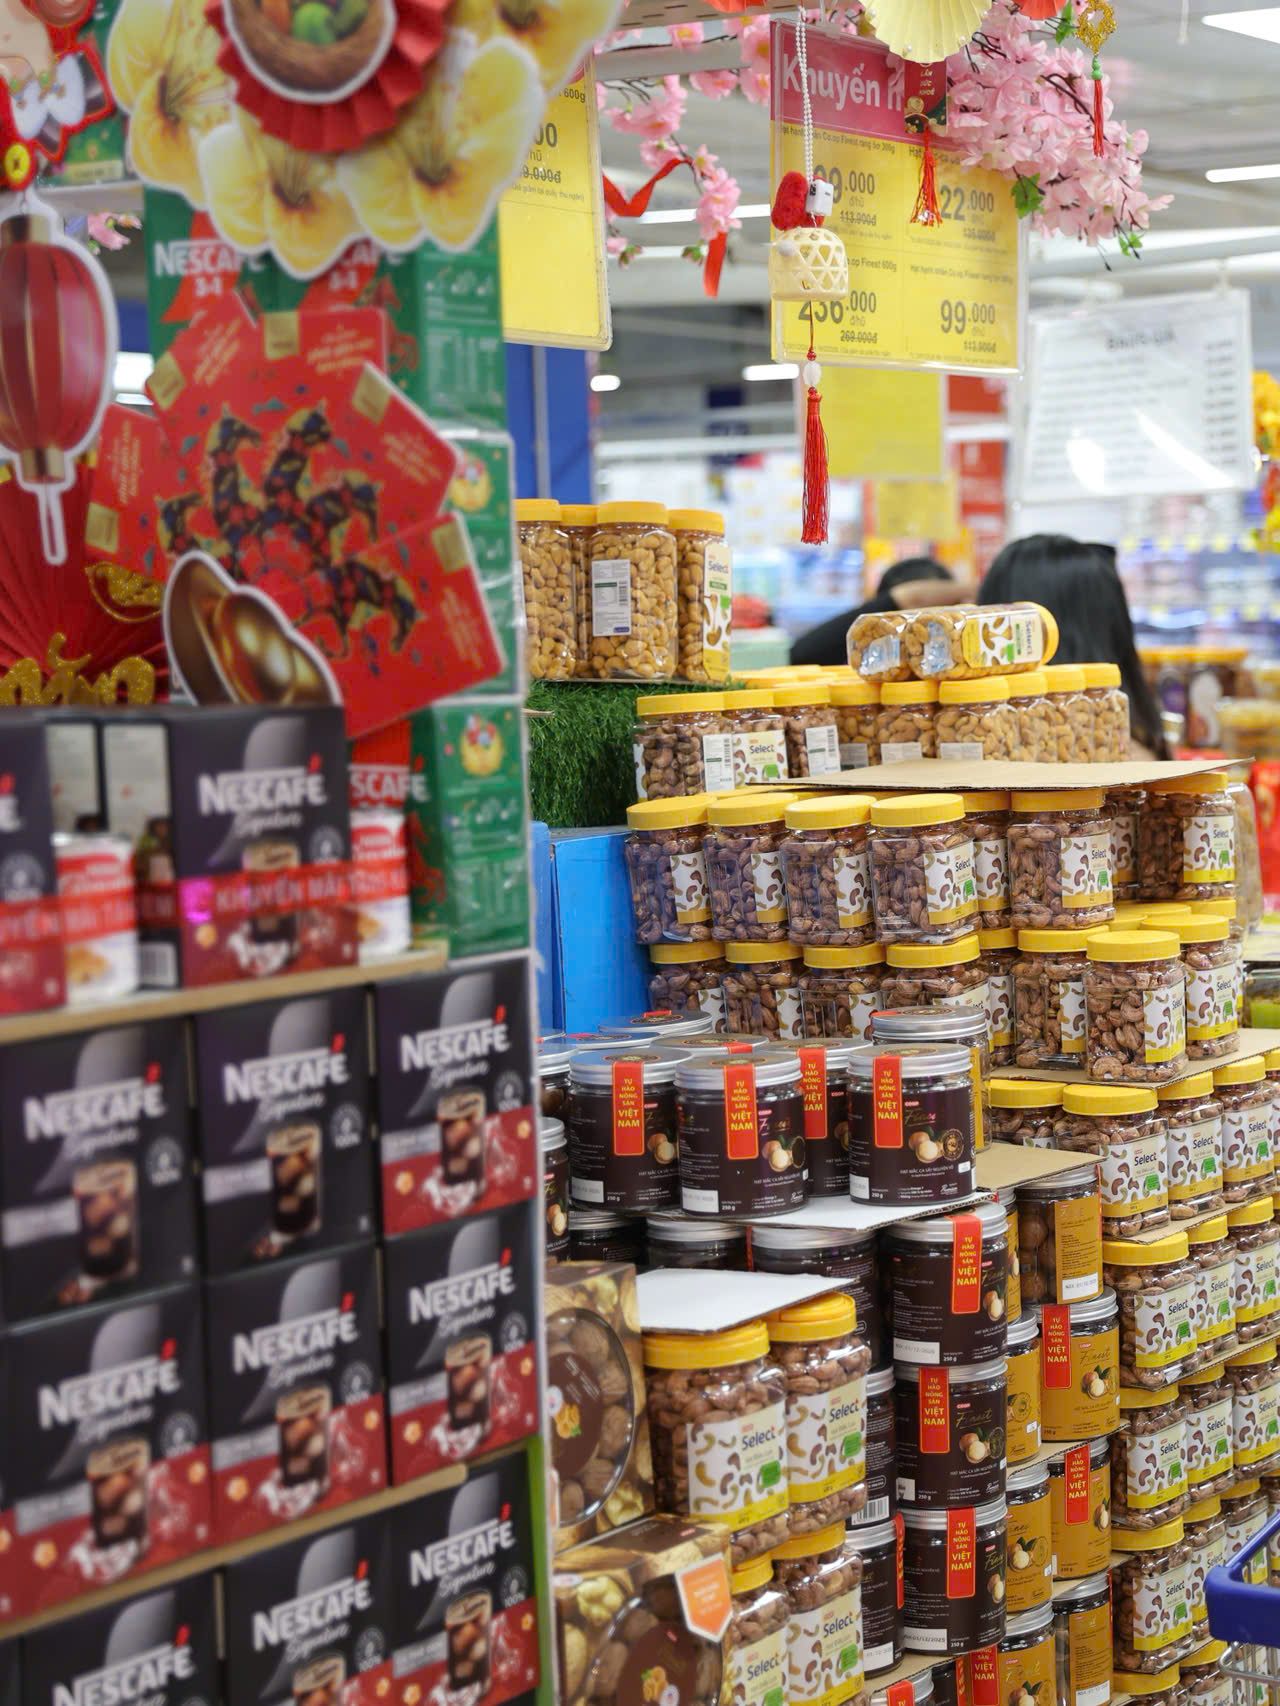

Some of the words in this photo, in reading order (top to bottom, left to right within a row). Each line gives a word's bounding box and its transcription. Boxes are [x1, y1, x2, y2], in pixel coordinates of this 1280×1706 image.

[564, 88, 586, 103] 600g
[940, 299, 996, 335] 99.000
[749, 744, 775, 755] Select
[350, 755, 431, 804] SCAFÉ
[1213, 829, 1230, 839] Select
[1092, 849, 1107, 860] Select
[955, 860, 971, 872] Select
[1217, 981, 1231, 992] Select
[878, 1101, 897, 1111] VIỆT
[618, 1109, 638, 1119] VIỆT
[731, 1112, 751, 1123] VIỆT
[731, 1123, 753, 1131] NAM
[1249, 1120, 1267, 1133] Select
[1193, 1136, 1214, 1149] Select
[1134, 1152, 1157, 1166] Select
[1256, 1258, 1275, 1272] Select
[958, 1267, 977, 1277] VIỆT
[957, 1277, 977, 1285] NAM
[1210, 1278, 1230, 1292] Select
[1168, 1300, 1189, 1315] Select
[1048, 1346, 1066, 1355] VIỆT
[829, 1399, 859, 1423] Select
[1258, 1398, 1276, 1413] Select
[924, 1407, 944, 1417] VIỆT
[1207, 1417, 1227, 1433] Select
[742, 1425, 776, 1451] Select
[1160, 1440, 1180, 1455] Select
[1069, 1480, 1086, 1489] VIỆT
[1068, 1491, 1087, 1499] NAM
[953, 1535, 970, 1543] NÔNG
[952, 1552, 971, 1561] VIỆT
[1206, 1552, 1223, 1568] Select
[951, 1562, 972, 1571] NAM
[1166, 1581, 1186, 1598] Select
[823, 1610, 854, 1639] Select
[747, 1652, 780, 1681] Select
[975, 1663, 993, 1672] VIỆT
